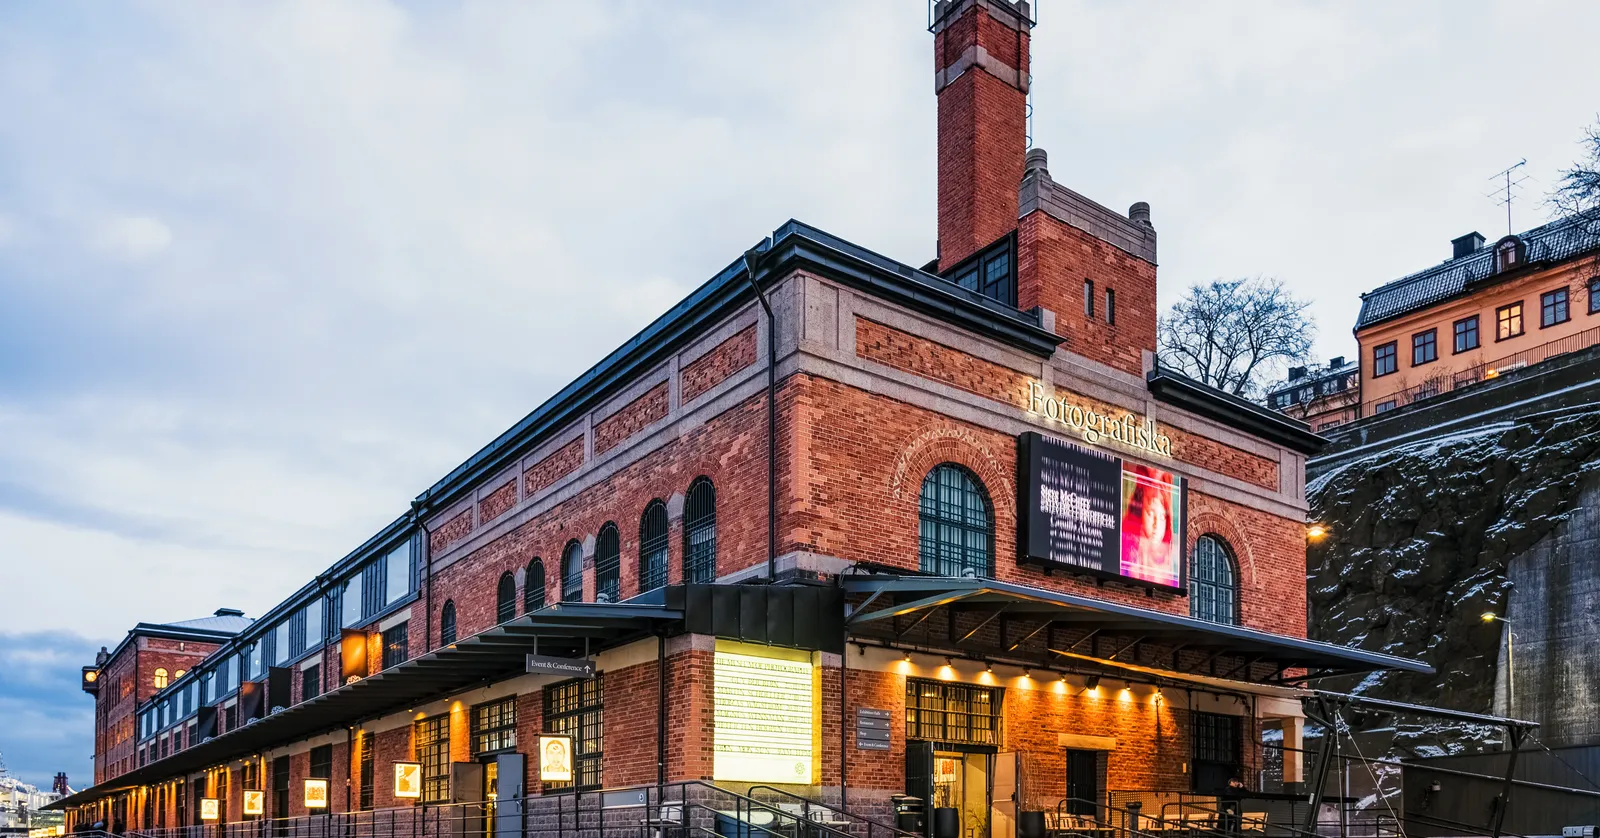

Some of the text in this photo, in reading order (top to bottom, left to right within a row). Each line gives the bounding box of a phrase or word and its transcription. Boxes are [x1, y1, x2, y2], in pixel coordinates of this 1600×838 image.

[1027, 380, 1172, 457] Fotografiska
[531, 660, 582, 671] Event & Conference
